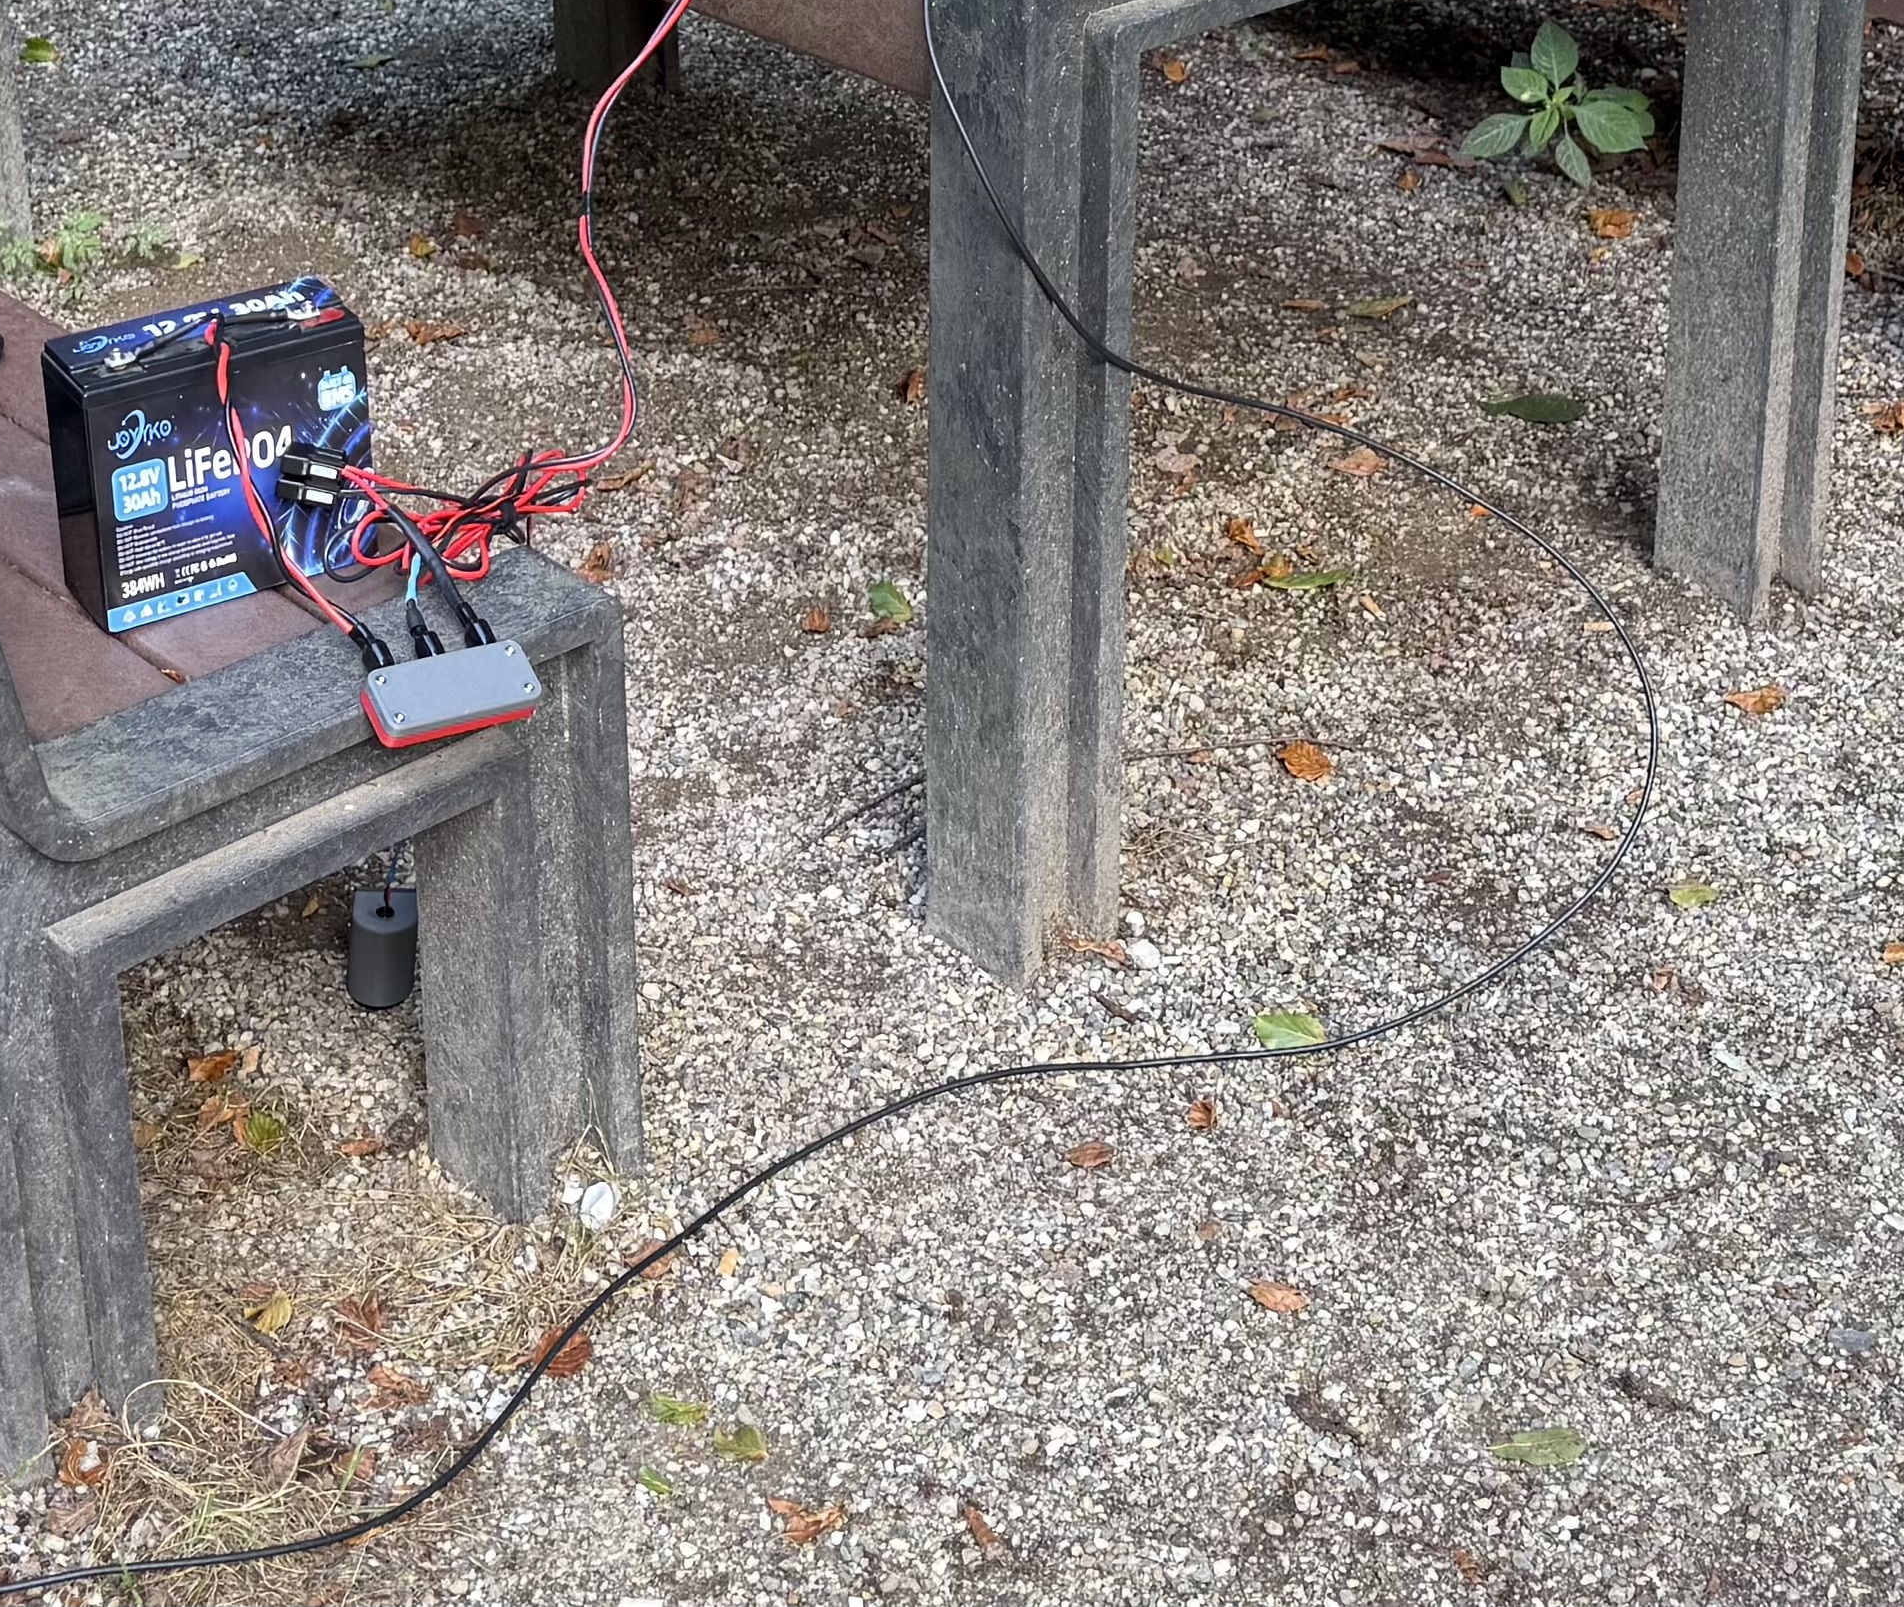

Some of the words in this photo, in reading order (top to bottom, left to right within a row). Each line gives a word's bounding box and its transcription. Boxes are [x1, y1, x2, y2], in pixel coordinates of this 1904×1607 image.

[229, 289, 306, 316] 30Ah
[119, 466, 161, 493] 12.8V
[123, 489, 162, 514] 30Ah
[121, 572, 165, 599] 384WH
